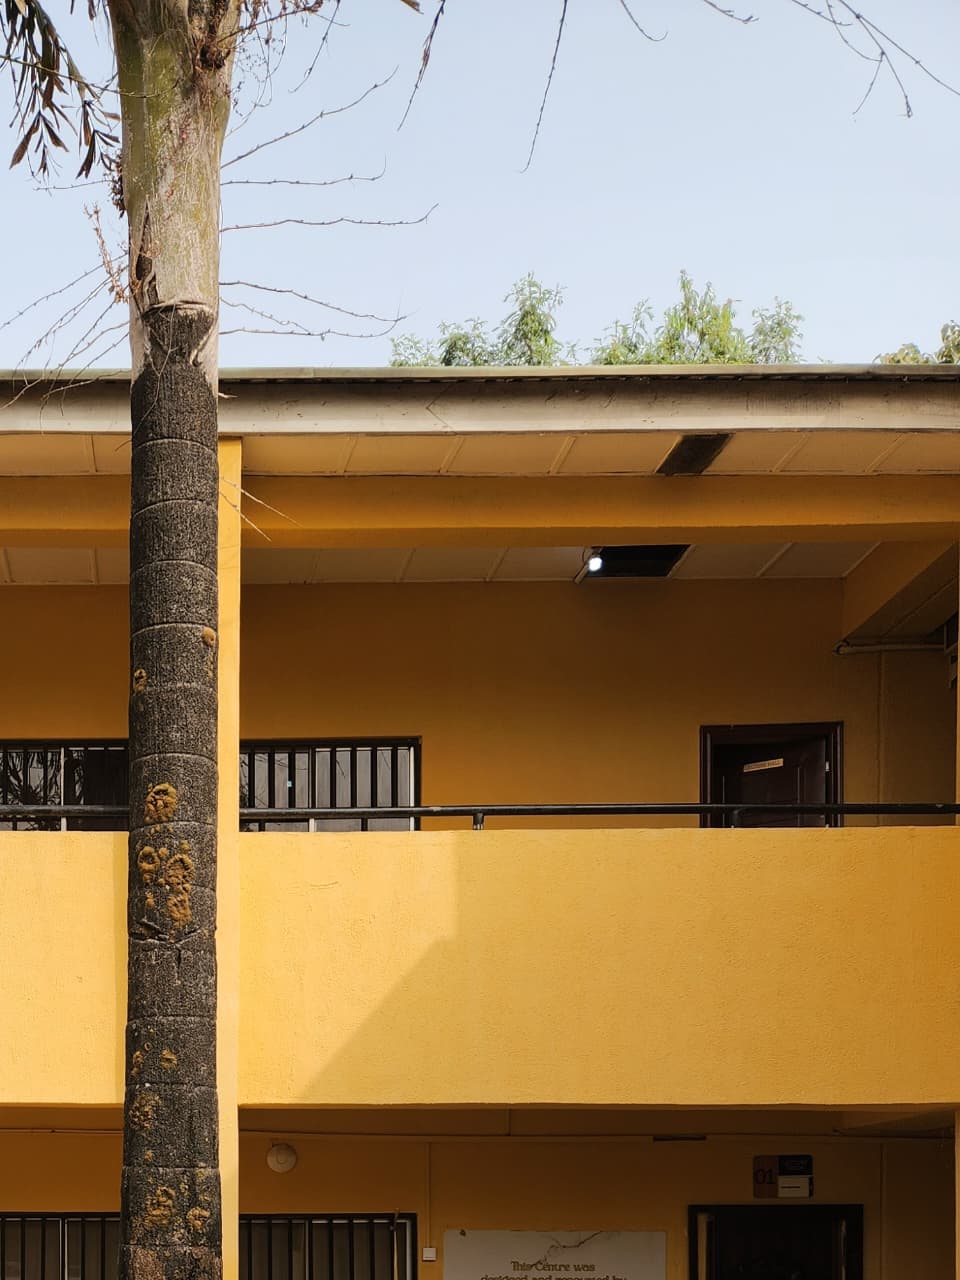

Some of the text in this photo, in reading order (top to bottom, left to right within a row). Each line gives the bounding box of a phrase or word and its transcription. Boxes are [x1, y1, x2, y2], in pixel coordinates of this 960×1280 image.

[755, 1168, 777, 1185] 01
[511, 1261, 596, 1272] This Centre was
